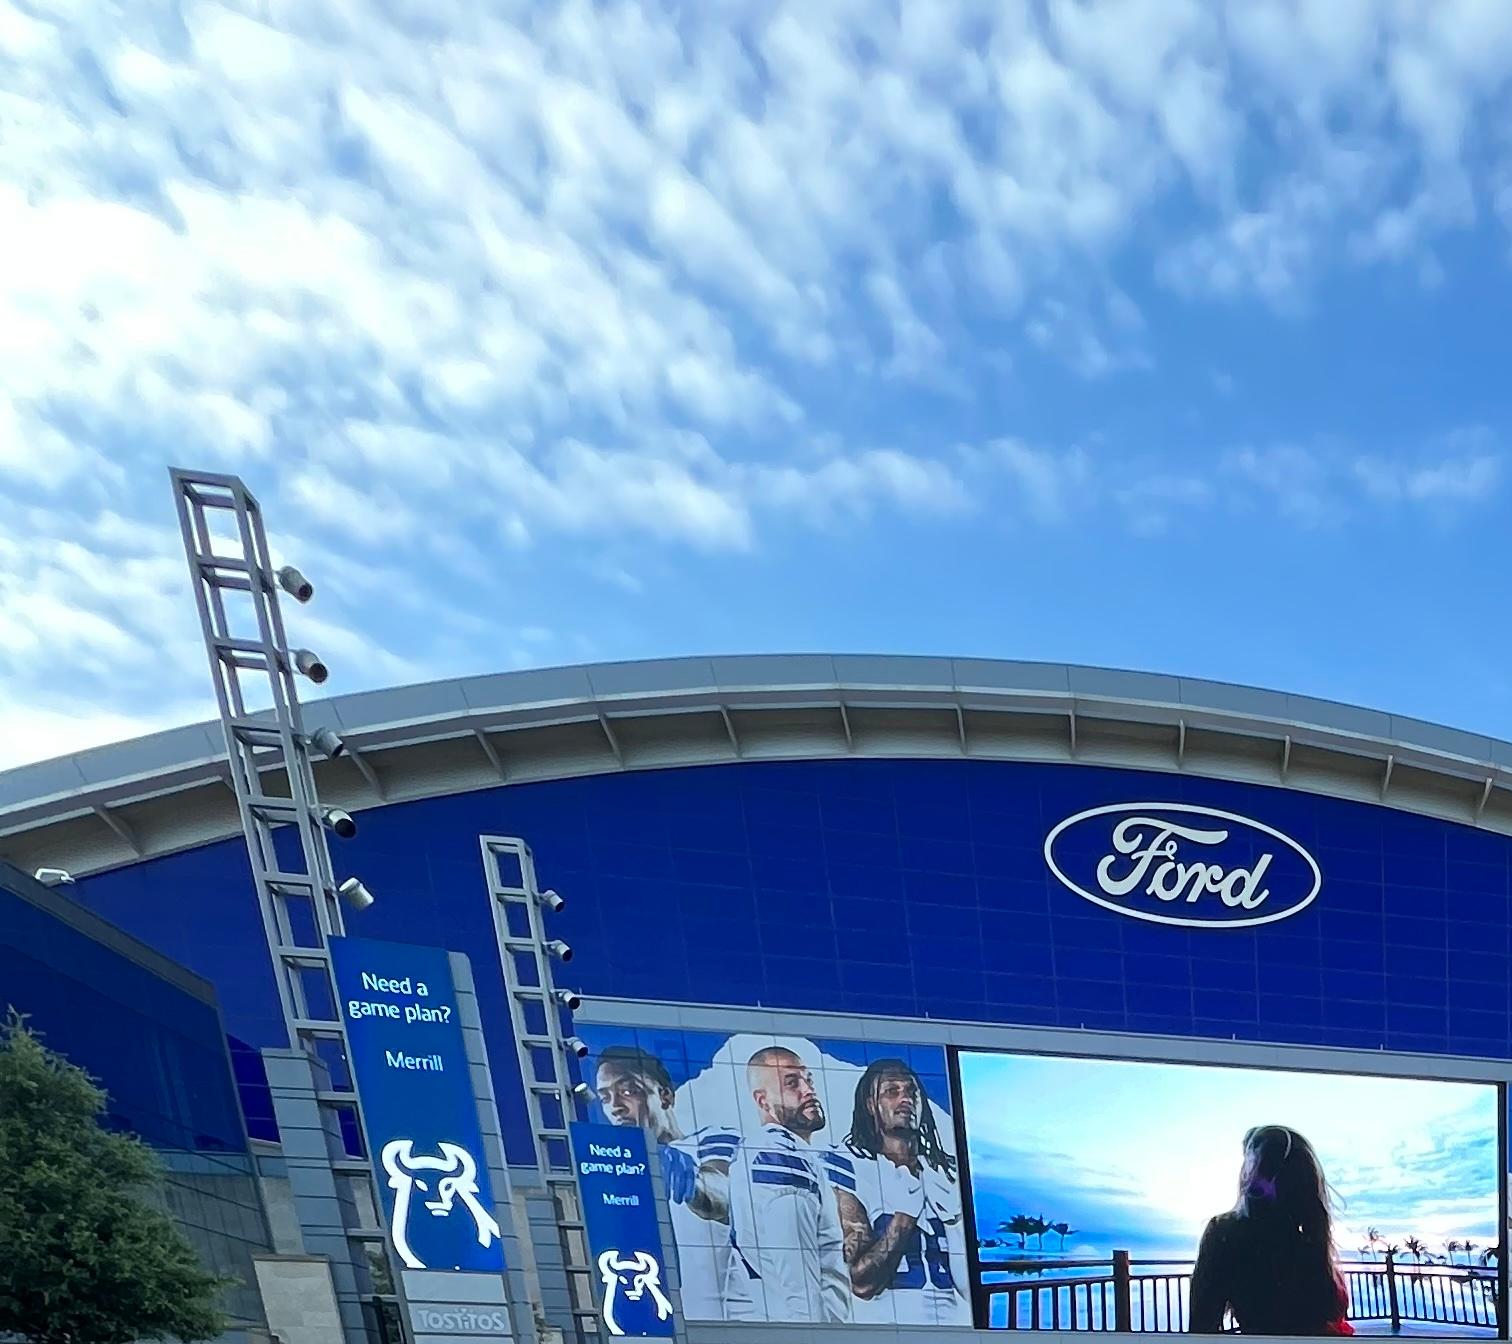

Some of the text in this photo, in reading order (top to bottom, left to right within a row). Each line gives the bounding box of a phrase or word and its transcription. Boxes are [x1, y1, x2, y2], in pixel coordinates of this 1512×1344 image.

[1097, 817, 1273, 909] Ford
[361, 972, 429, 996] Need a
[348, 1000, 451, 1024] game plan?
[385, 1050, 444, 1072] Merrill
[588, 1143, 632, 1159] Need a
[580, 1162, 646, 1176] game plan?
[602, 1193, 640, 1206] Merrill
